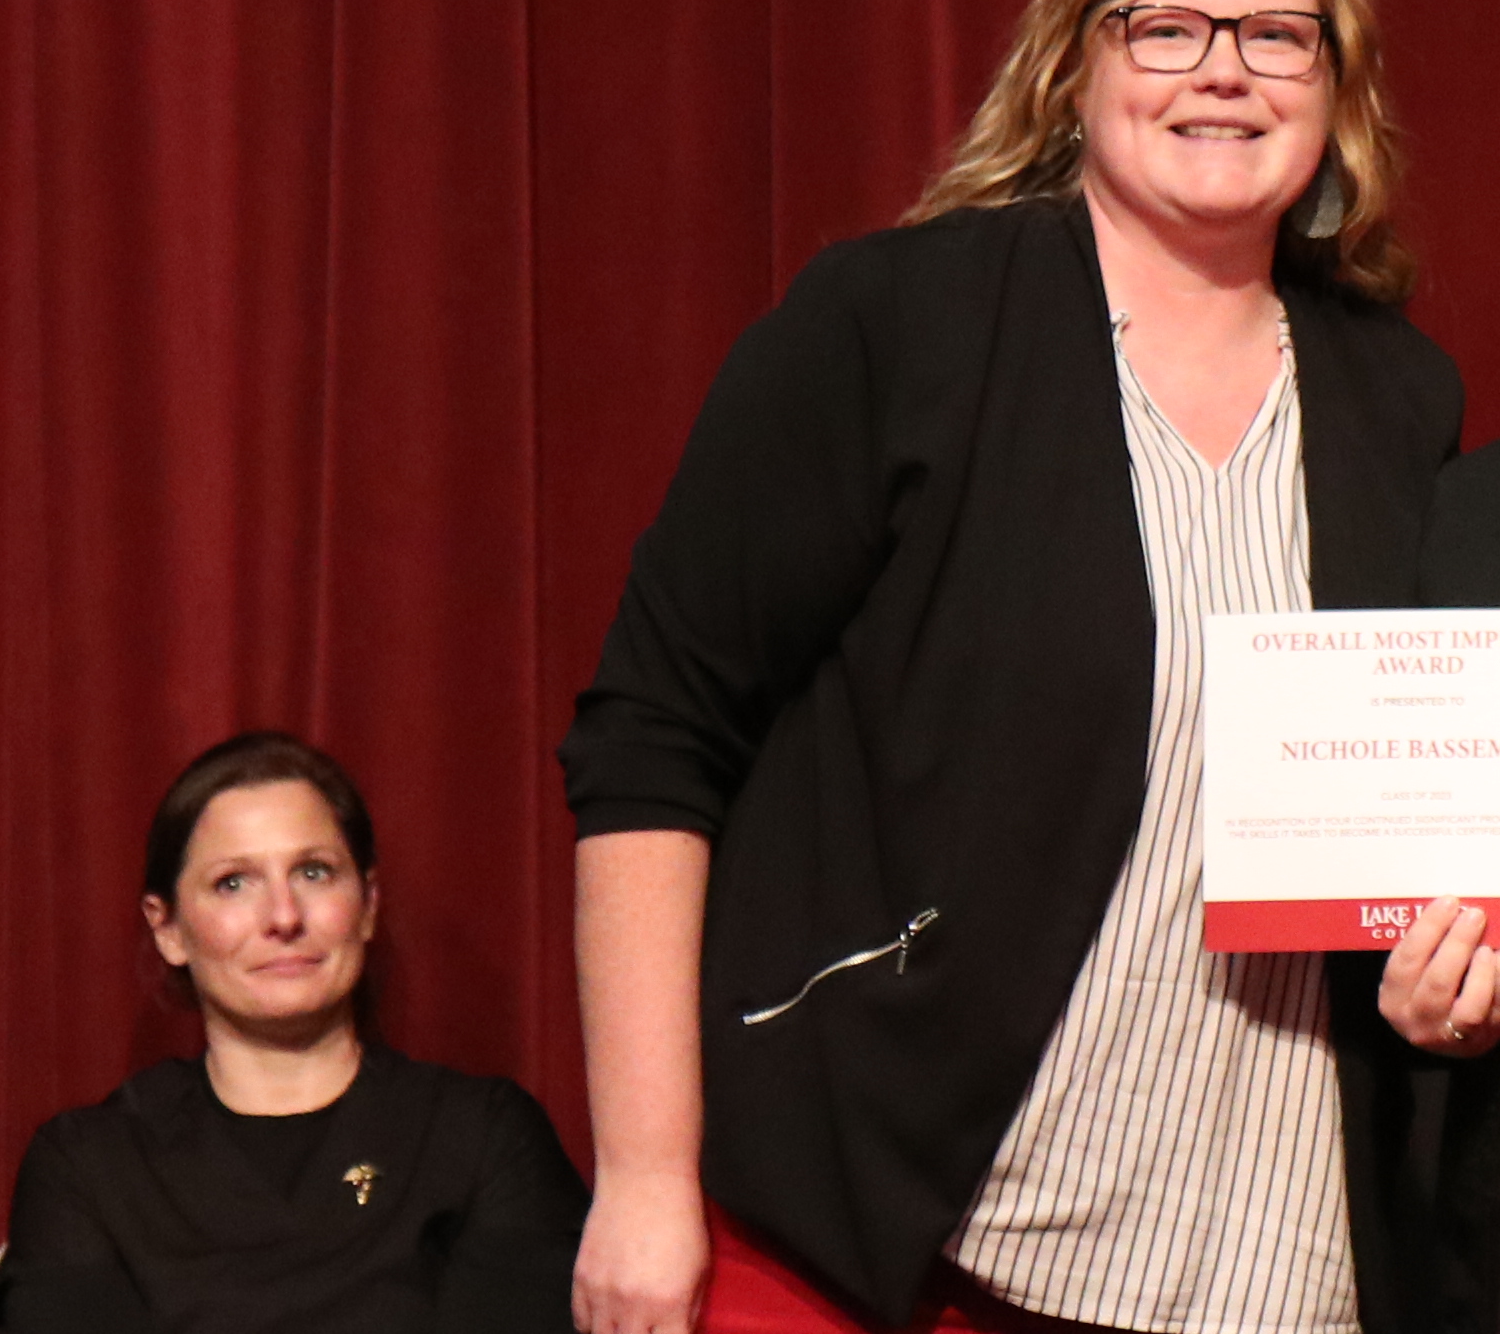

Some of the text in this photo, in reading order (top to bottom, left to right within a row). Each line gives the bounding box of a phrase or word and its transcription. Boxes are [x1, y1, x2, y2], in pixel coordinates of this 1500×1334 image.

[1252, 631, 1366, 652] OVERALL
[1374, 630, 1444, 650] MOST
[1373, 656, 1464, 675] AWARD
[1371, 696, 1464, 707] IS PRESENTED TO
[1281, 740, 1400, 761] NICHOLE
[1360, 905, 1410, 927] LAKE
